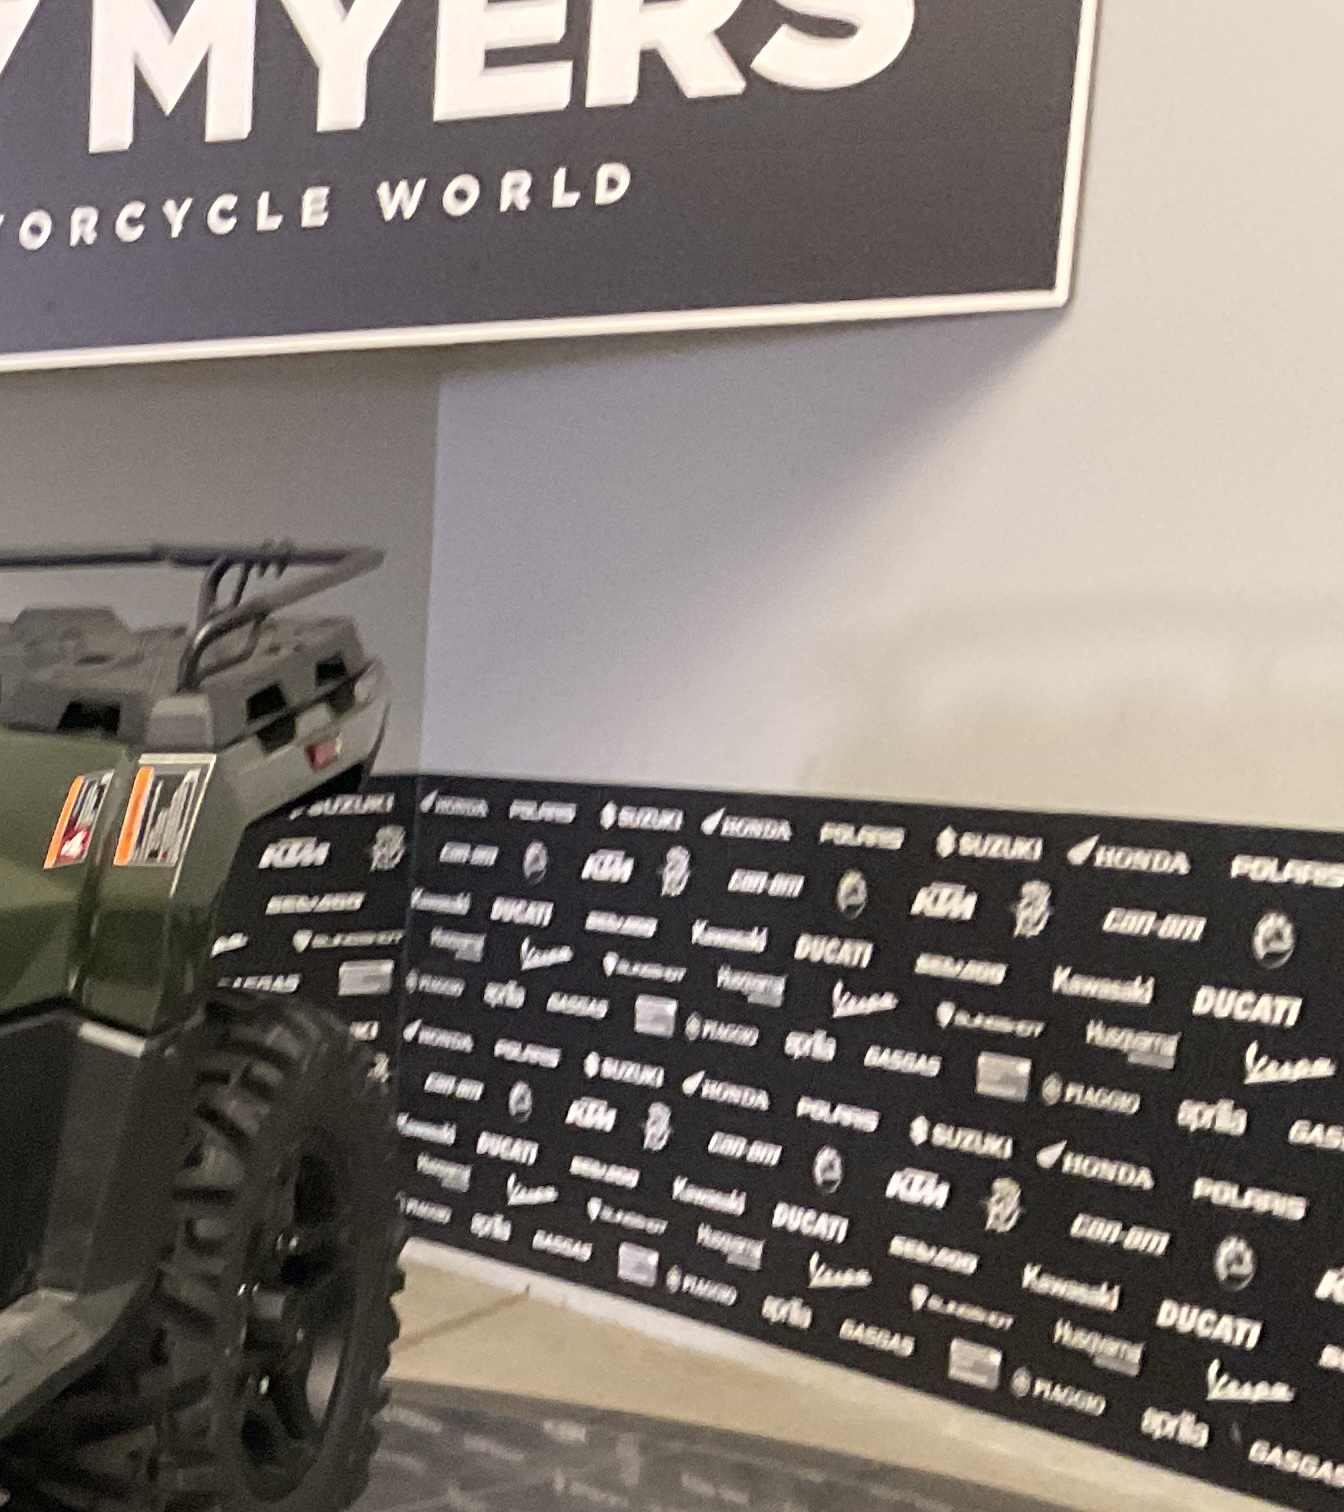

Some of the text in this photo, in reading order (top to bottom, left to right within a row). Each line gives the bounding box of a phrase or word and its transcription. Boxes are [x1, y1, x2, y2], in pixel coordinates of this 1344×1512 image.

[88, 0, 916, 153] MYERS
[376, 162, 633, 220] WORLD
[259, 836, 331, 869] KTM
[957, 831, 1044, 862] SUZUKI
[1092, 844, 1192, 876] HONDA
[910, 882, 978, 921] KTM
[793, 933, 874, 969] DUCATI
[1191, 984, 1303, 1028] DUCATI
[863, 1045, 942, 1078] GASGAS
[1063, 1082, 1142, 1116] PIAGGIO
[1177, 1098, 1248, 1136] aprilia
[930, 1122, 1014, 1160] SUZUKI
[885, 1167, 950, 1210] KTM
[1061, 1151, 1155, 1191] HONDA
[1192, 1177, 1307, 1221] POLARIS
[771, 1201, 849, 1244] DUCATI
[839, 1318, 915, 1357] GASGAS
[1155, 1299, 1262, 1350] DUCATI
[1141, 1406, 1210, 1448] aprilia
